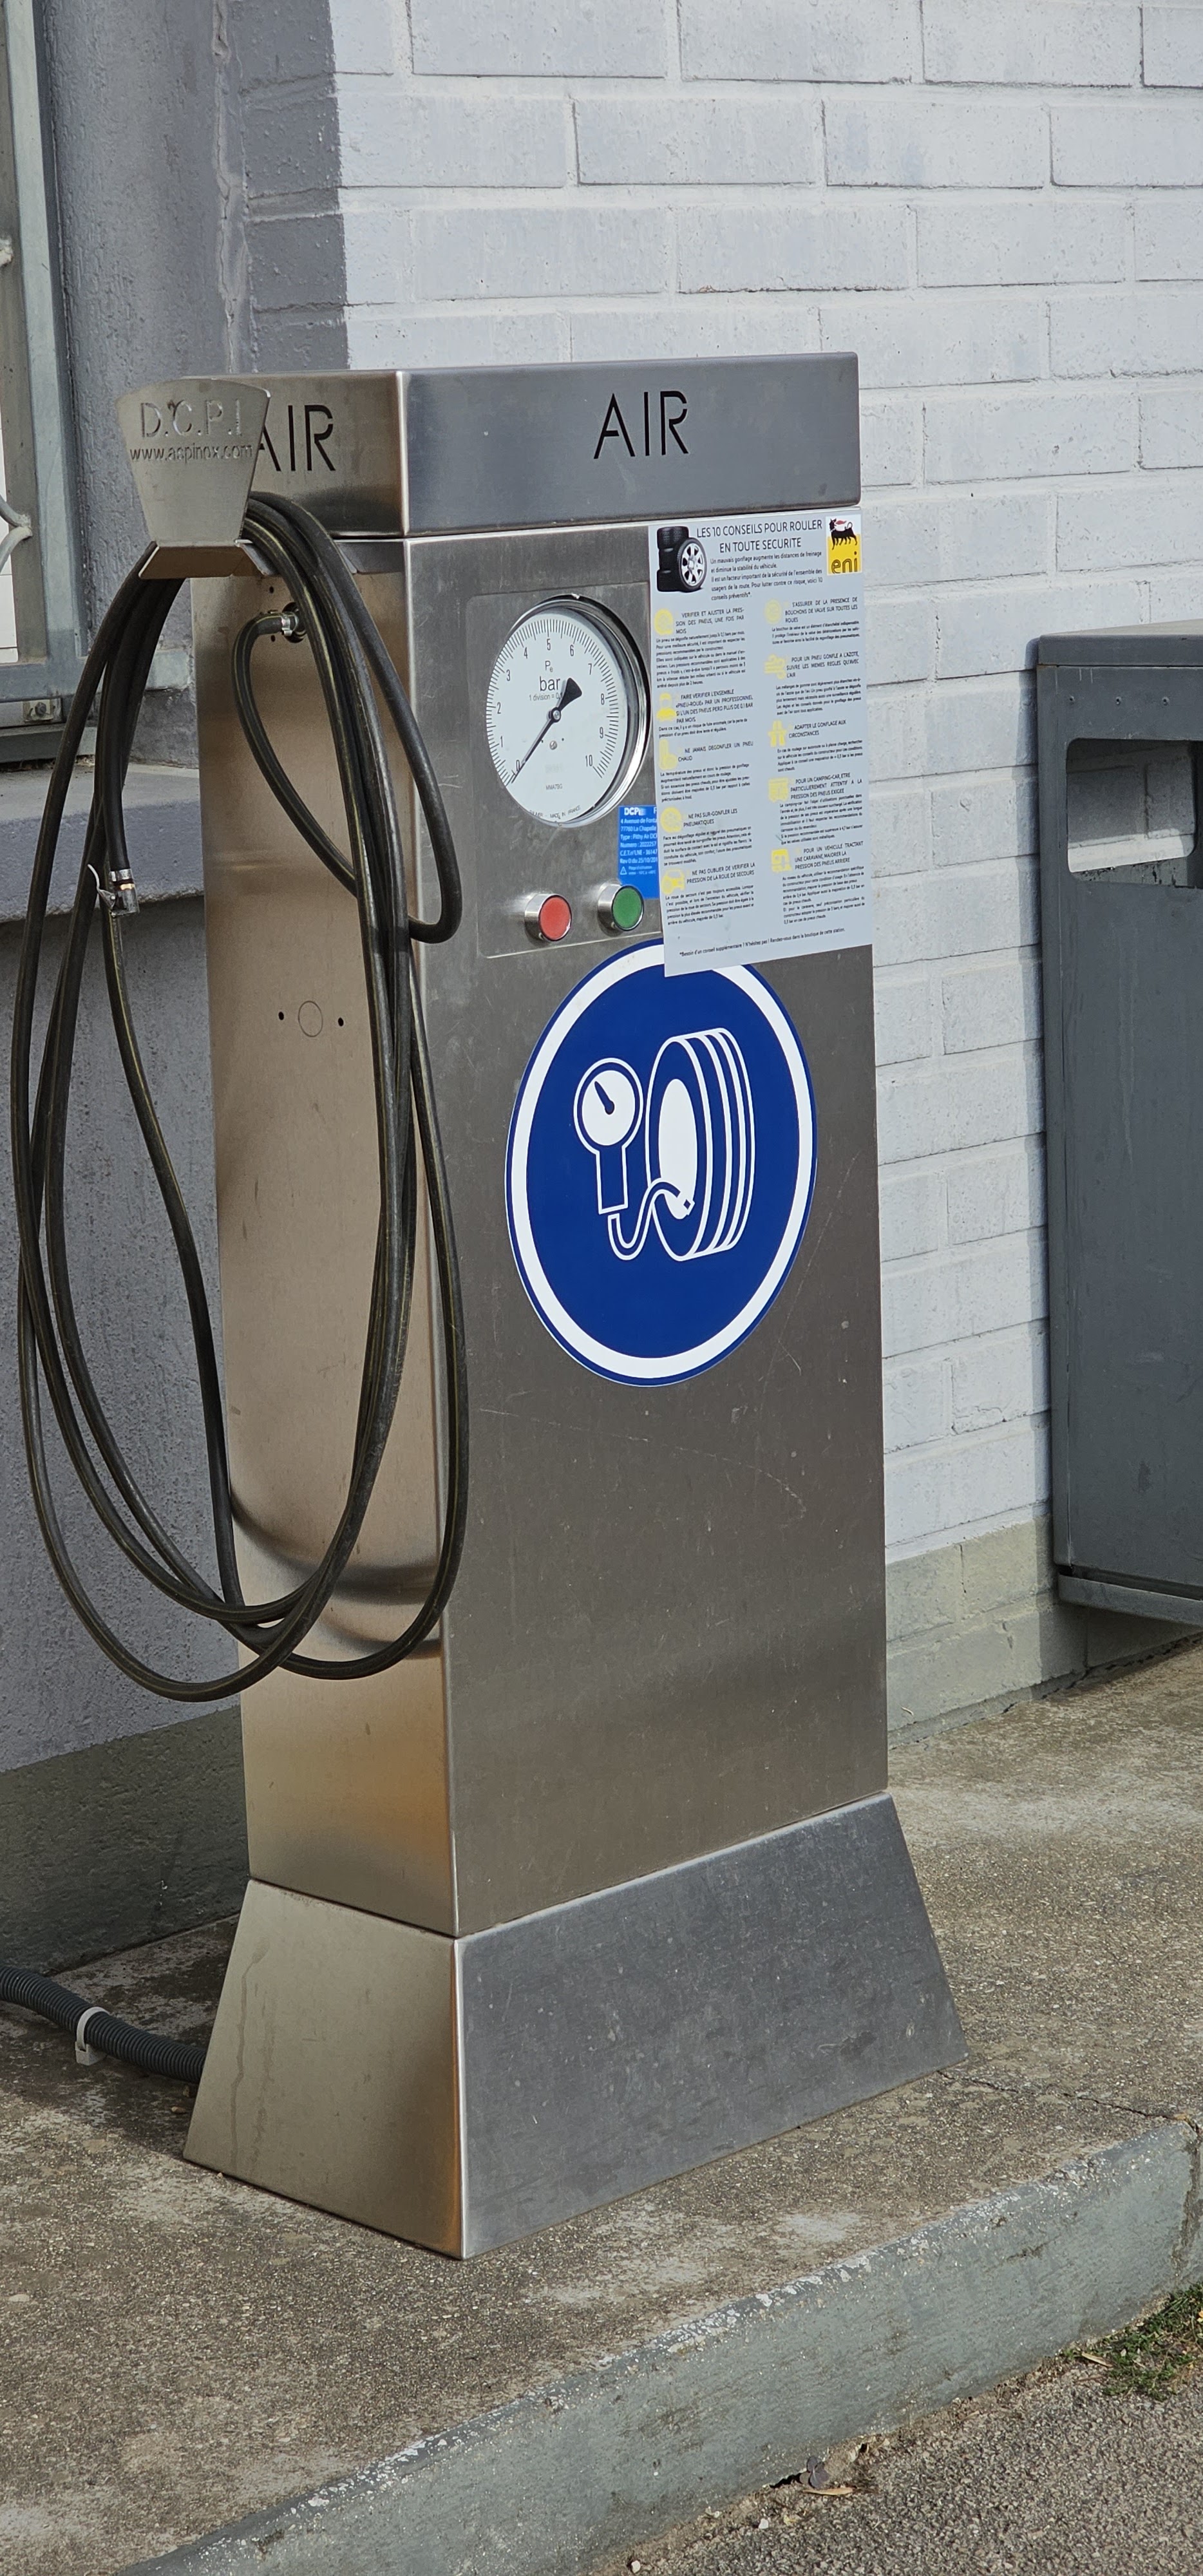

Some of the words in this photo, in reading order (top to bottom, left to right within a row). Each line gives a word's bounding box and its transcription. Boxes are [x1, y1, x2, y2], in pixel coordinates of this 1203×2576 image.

[594, 391, 688, 459] AIR
[130, 443, 252, 466] www.aspinox.com
[697, 527, 711, 538] LES
[712, 527, 721, 537] 10
[723, 524, 763, 536] CONSEILS
[764, 522, 788, 533] POUR
[790, 520, 822, 531] ROULER
[719, 543, 731, 553] EN
[732, 541, 760, 552] TOUTE
[762, 538, 801, 550] SECURITE
[831, 551, 858, 574] eni
[547, 638, 551, 650] 5
[524, 647, 528, 659] 4
[569, 645, 574, 657] 6
[588, 663, 592, 675] 7
[506, 670, 511, 681] 3
[540, 676, 560, 692] bar
[600, 694, 605, 705] 8
[497, 702, 501, 714] 2
[599, 727, 603, 739] 9
[500, 735, 503, 747] 1
[516, 760, 520, 772] 0
[585, 755, 592, 767] 10
